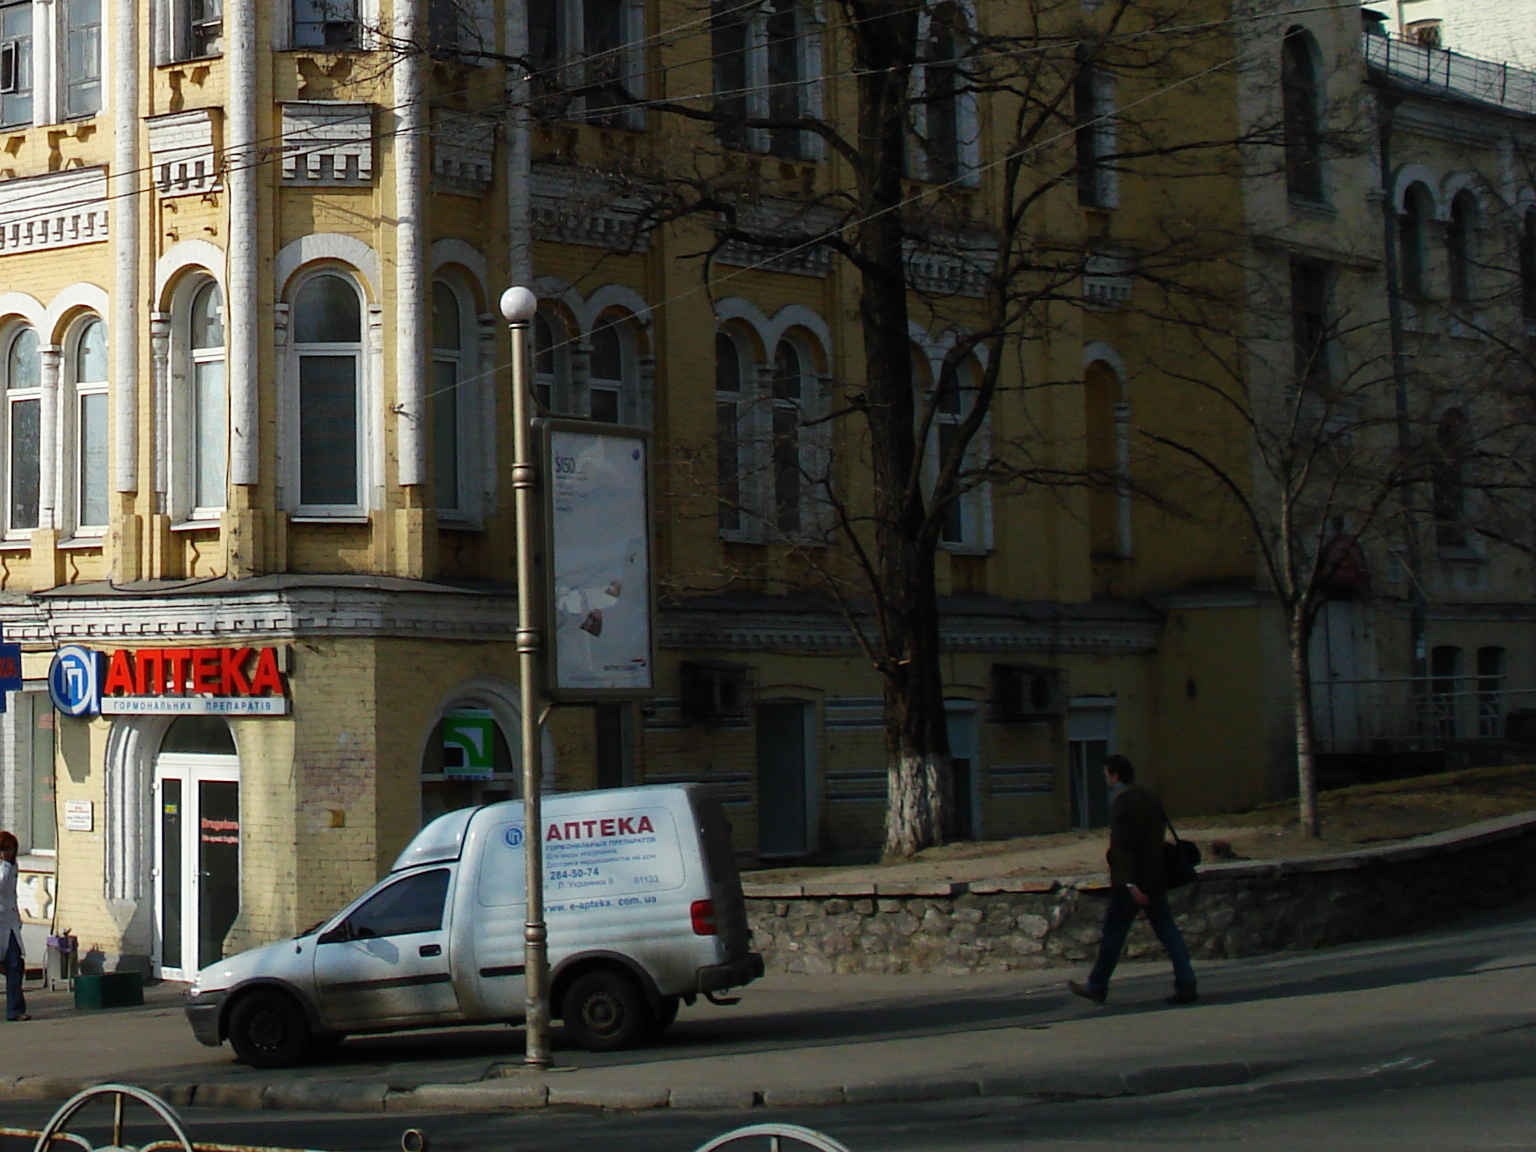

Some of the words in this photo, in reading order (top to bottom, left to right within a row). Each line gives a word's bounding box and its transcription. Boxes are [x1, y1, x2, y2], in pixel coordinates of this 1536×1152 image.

[103, 648, 283, 695] АПТЕКА
[114, 701, 192, 711] ГОРМОНАЛЬНИХ
[205, 701, 271, 711] ПРЕПАРАТІВ
[546, 816, 654, 841] АПТЕКА
